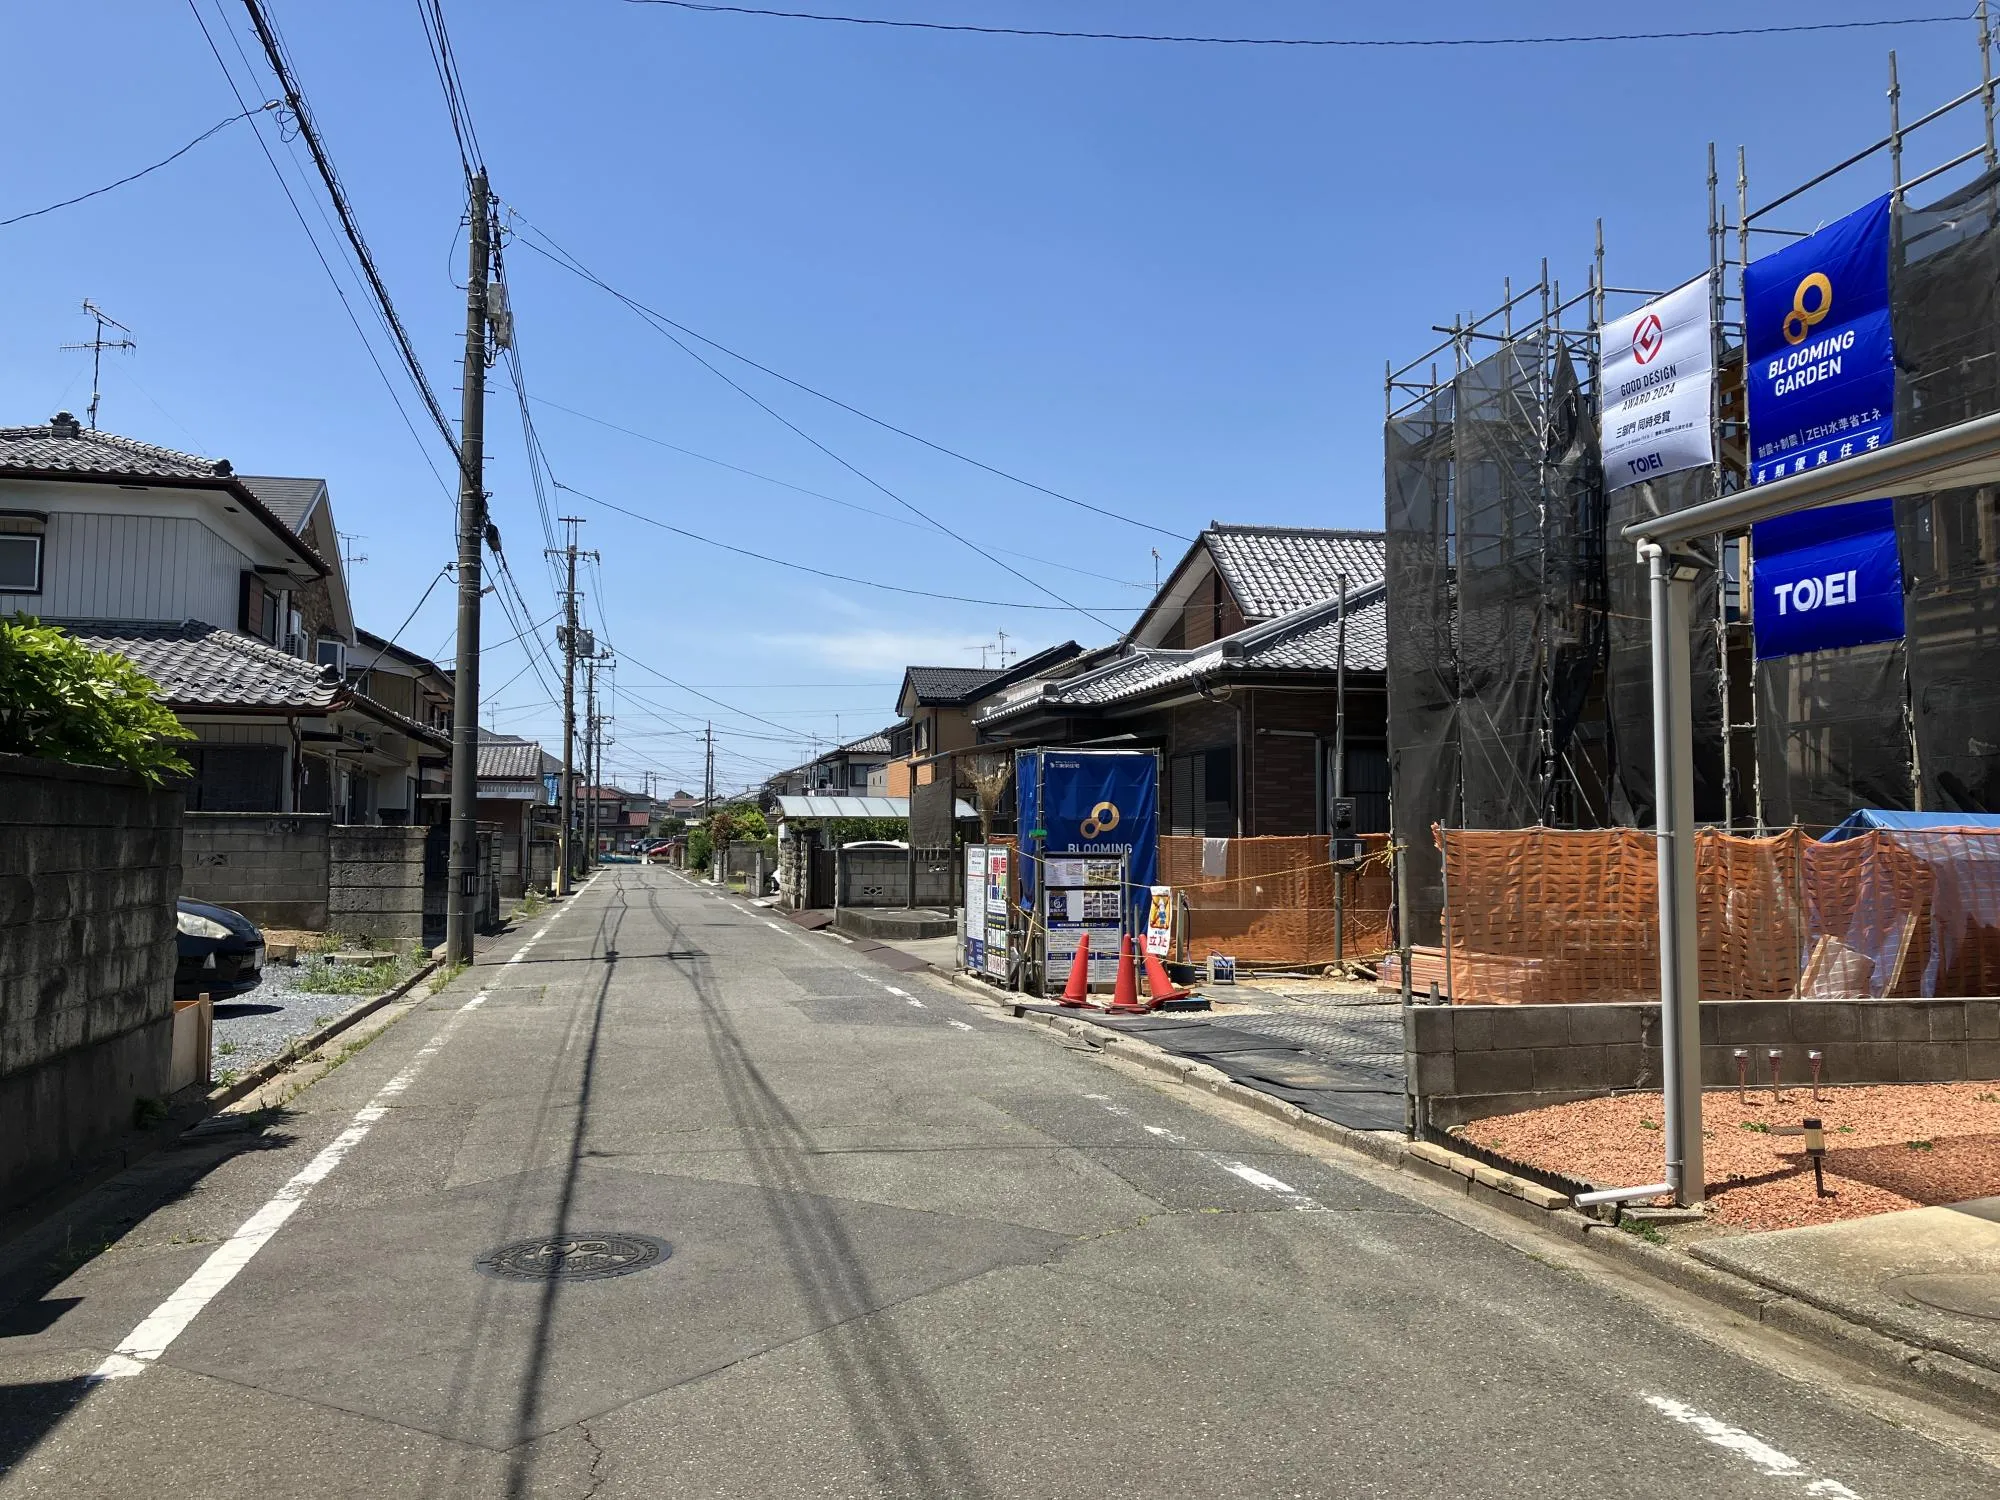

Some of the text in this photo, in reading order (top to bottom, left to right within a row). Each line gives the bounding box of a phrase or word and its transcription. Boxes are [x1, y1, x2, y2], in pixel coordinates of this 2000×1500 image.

[1768, 330, 1855, 380] BLOOMING
[1620, 364, 1677, 397] GOOD DESIGN
[1775, 356, 1842, 397] GARDEN
[1622, 381, 1676, 412] AWARD 2024
[1616, 421, 1636, 439] 三部門
[1638, 409, 1671, 432] 同時受賞
[1805, 408, 1882, 441] ZEH水準省エネ
[1627, 452, 1664, 475] TOEI
[1756, 434, 1881, 485] 長期優良住宅
[1774, 569, 1857, 616] TOEI
